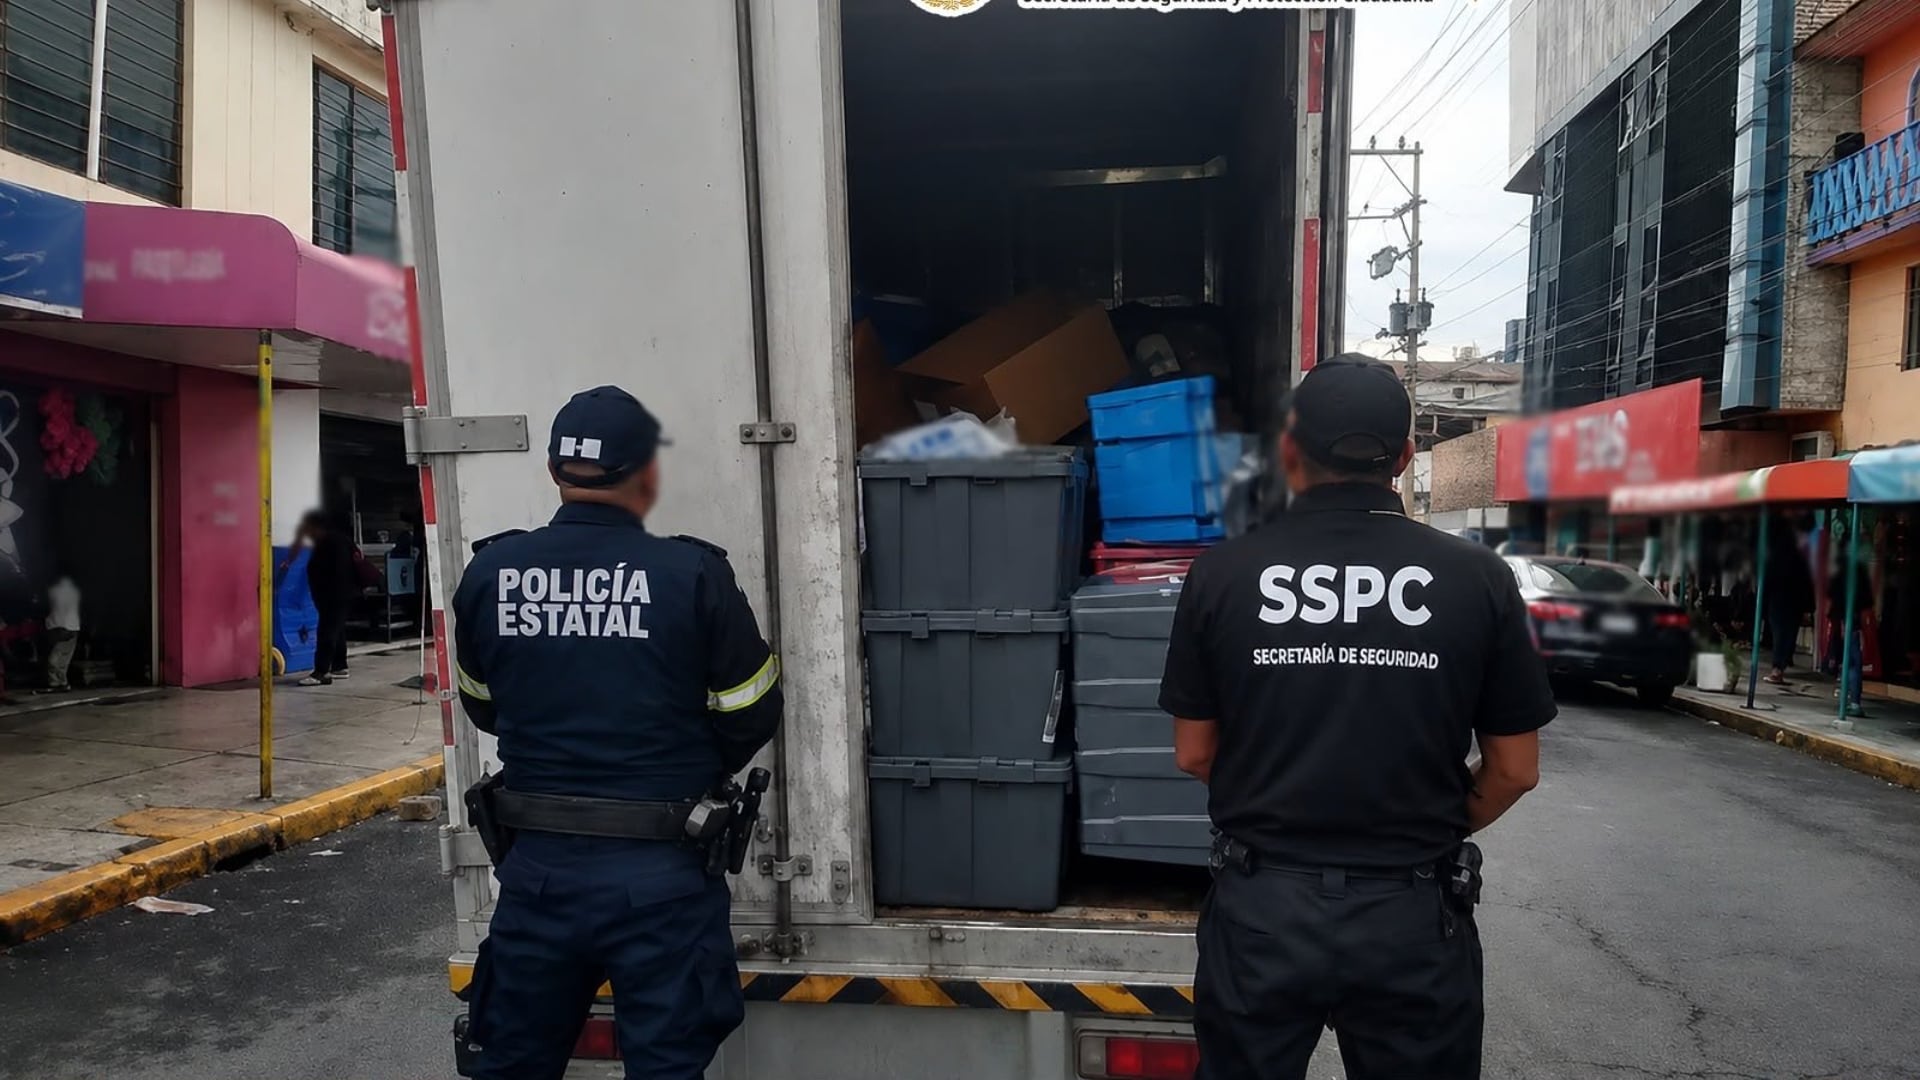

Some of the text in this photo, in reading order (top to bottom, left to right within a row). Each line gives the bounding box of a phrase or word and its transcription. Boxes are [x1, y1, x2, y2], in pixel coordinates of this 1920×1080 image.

[498, 562, 651, 604] POLICÍA
[1258, 564, 1434, 627] SSPC
[497, 603, 650, 638] ESTATAL
[1253, 642, 1439, 670] SECRETARÍA DE SEGURIDAD
